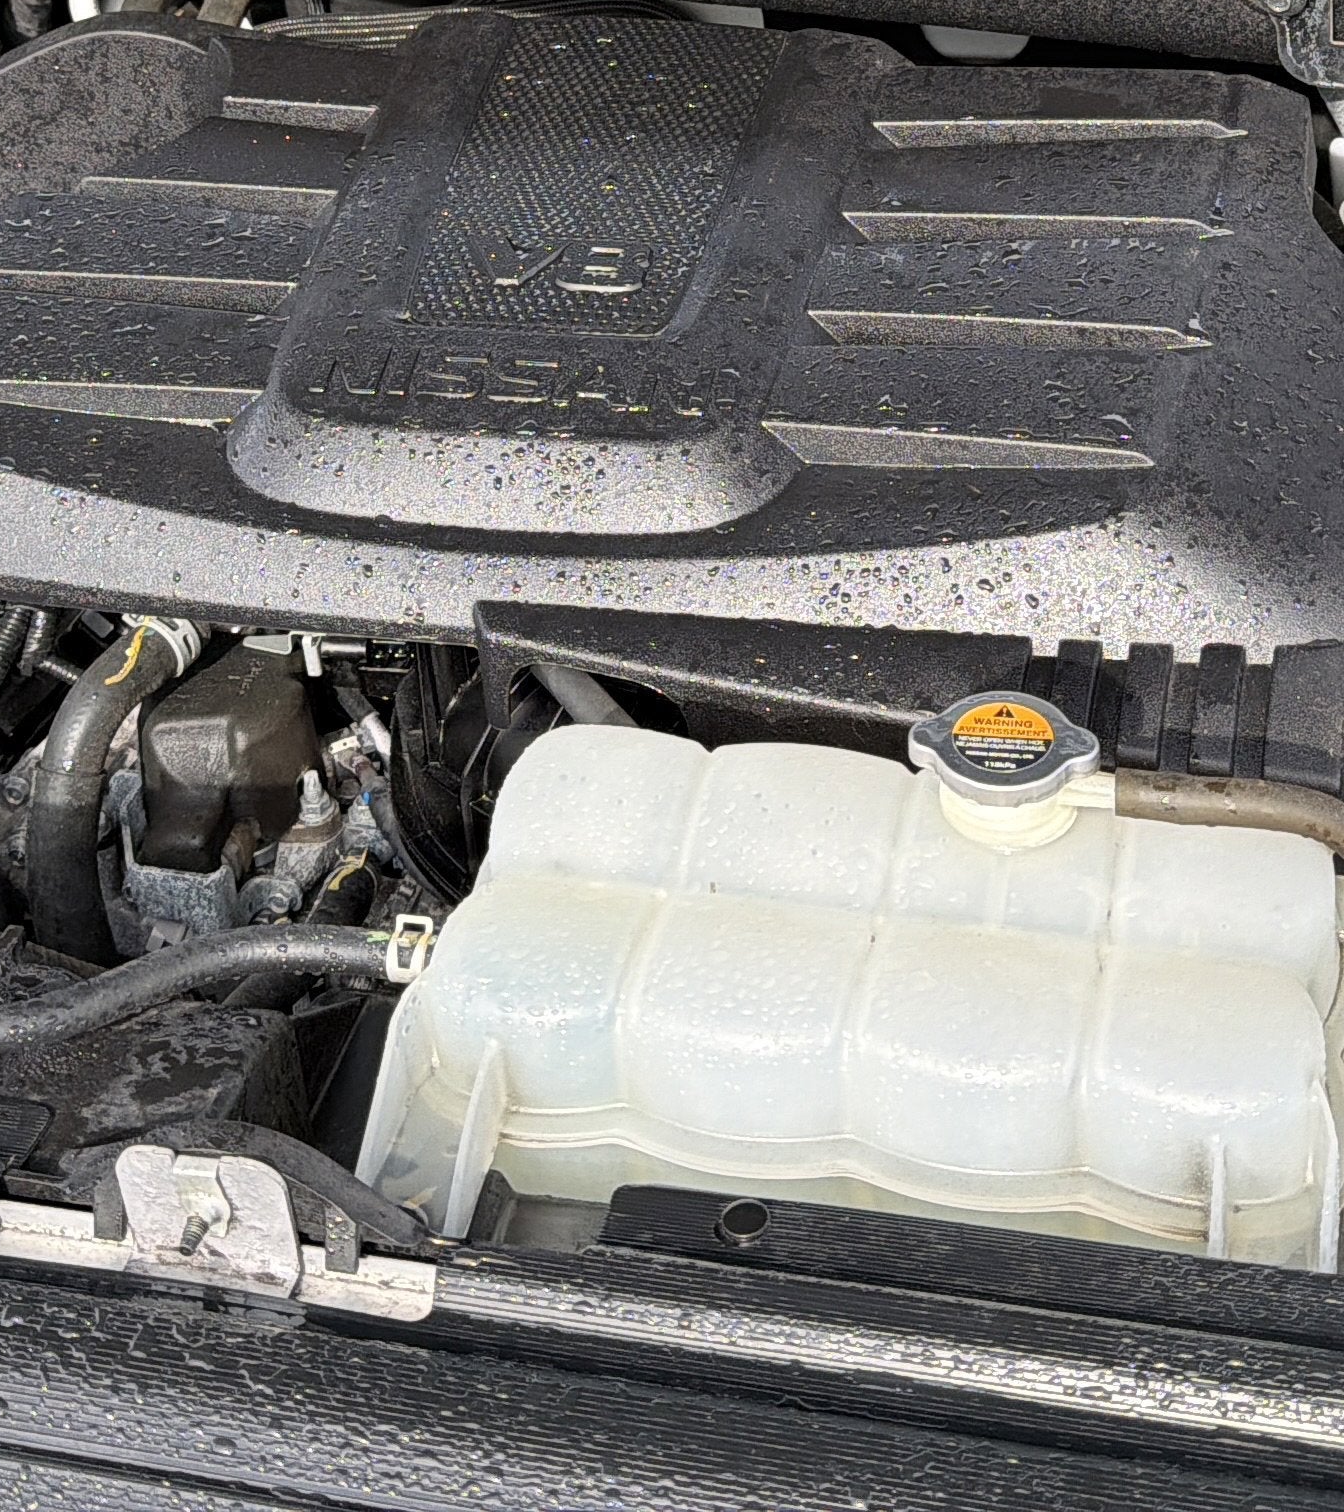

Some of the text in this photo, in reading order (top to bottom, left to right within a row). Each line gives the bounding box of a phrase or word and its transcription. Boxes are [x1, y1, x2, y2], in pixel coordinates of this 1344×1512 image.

[308, 345, 720, 416] NISSAN
[973, 717, 1033, 728] WARNING
[958, 725, 1048, 738] AVERTISSEMENT
